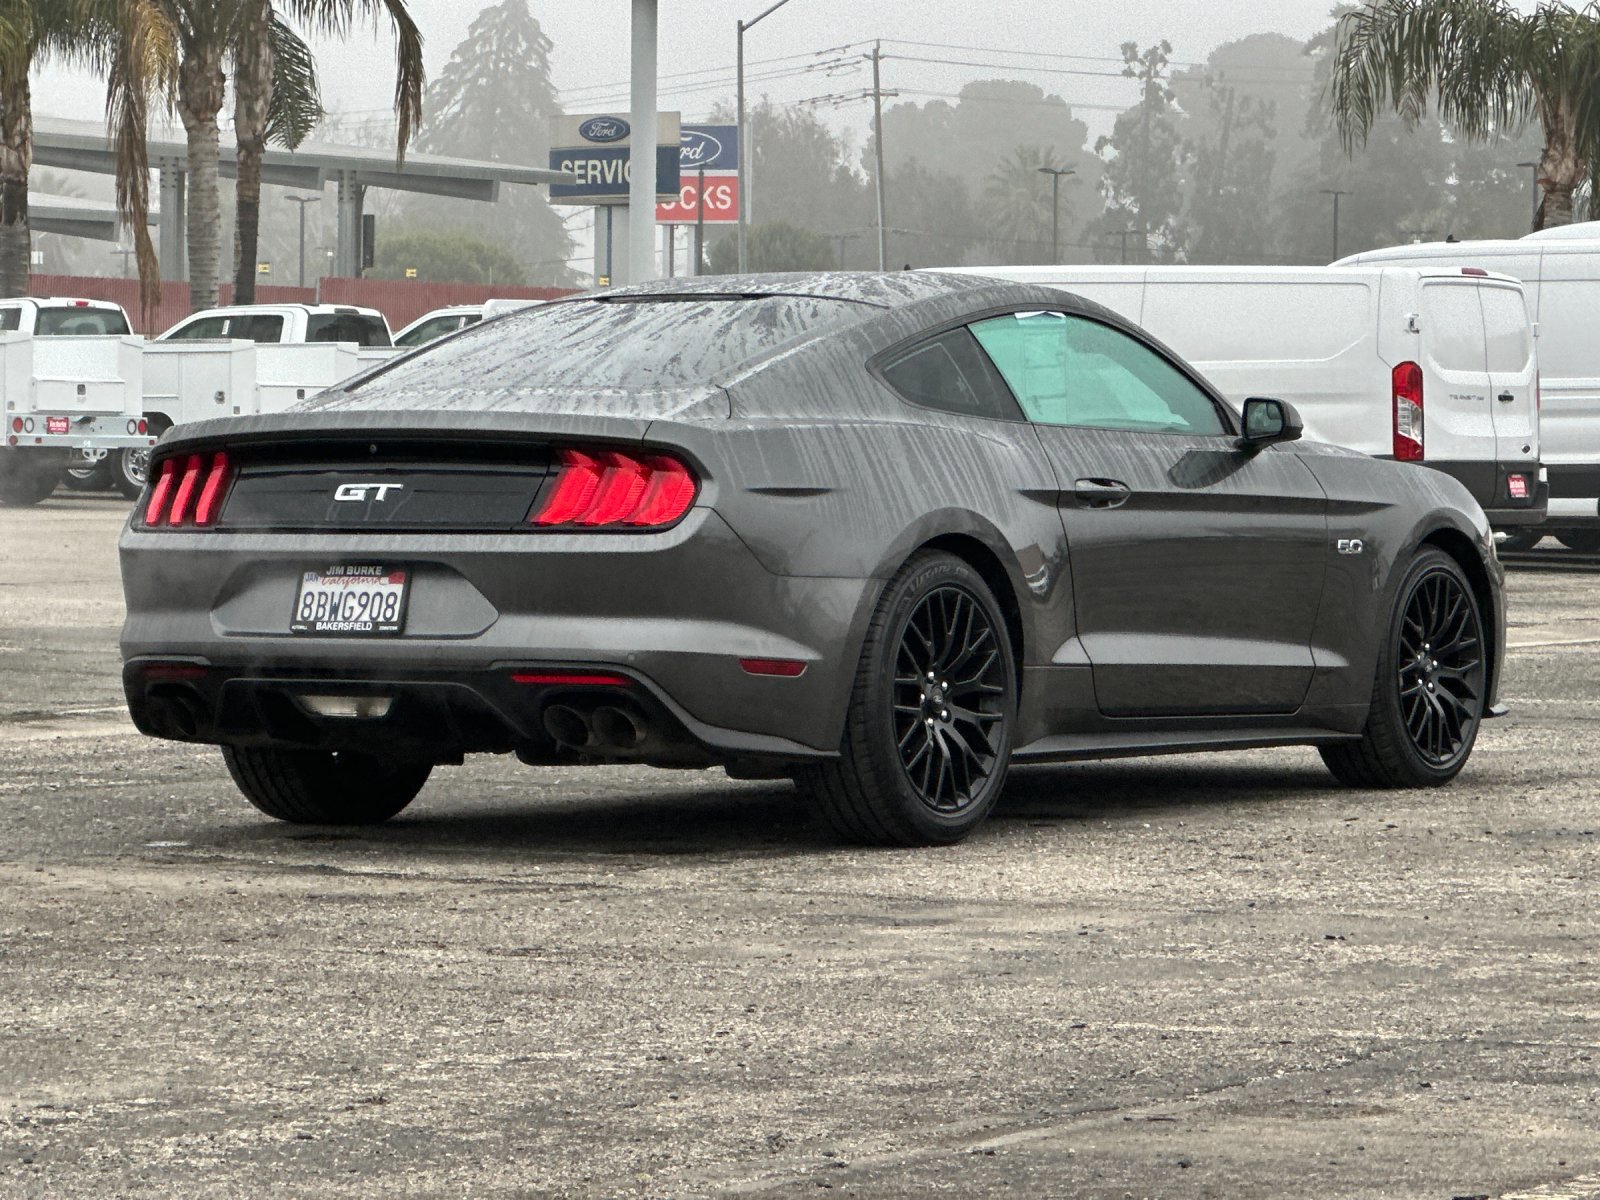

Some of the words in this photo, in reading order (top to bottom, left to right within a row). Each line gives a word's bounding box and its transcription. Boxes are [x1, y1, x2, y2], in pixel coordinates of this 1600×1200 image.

[589, 122, 616, 137] Ford
[680, 137, 705, 159] rd
[561, 160, 631, 185] SERVIC
[656, 185, 732, 210] CKS
[334, 483, 403, 501] GT
[326, 566, 344, 575] JIM
[347, 566, 383, 575] BURKE
[301, 591, 398, 621] 8BWG908
[316, 622, 373, 631] BAKERSFIELD
